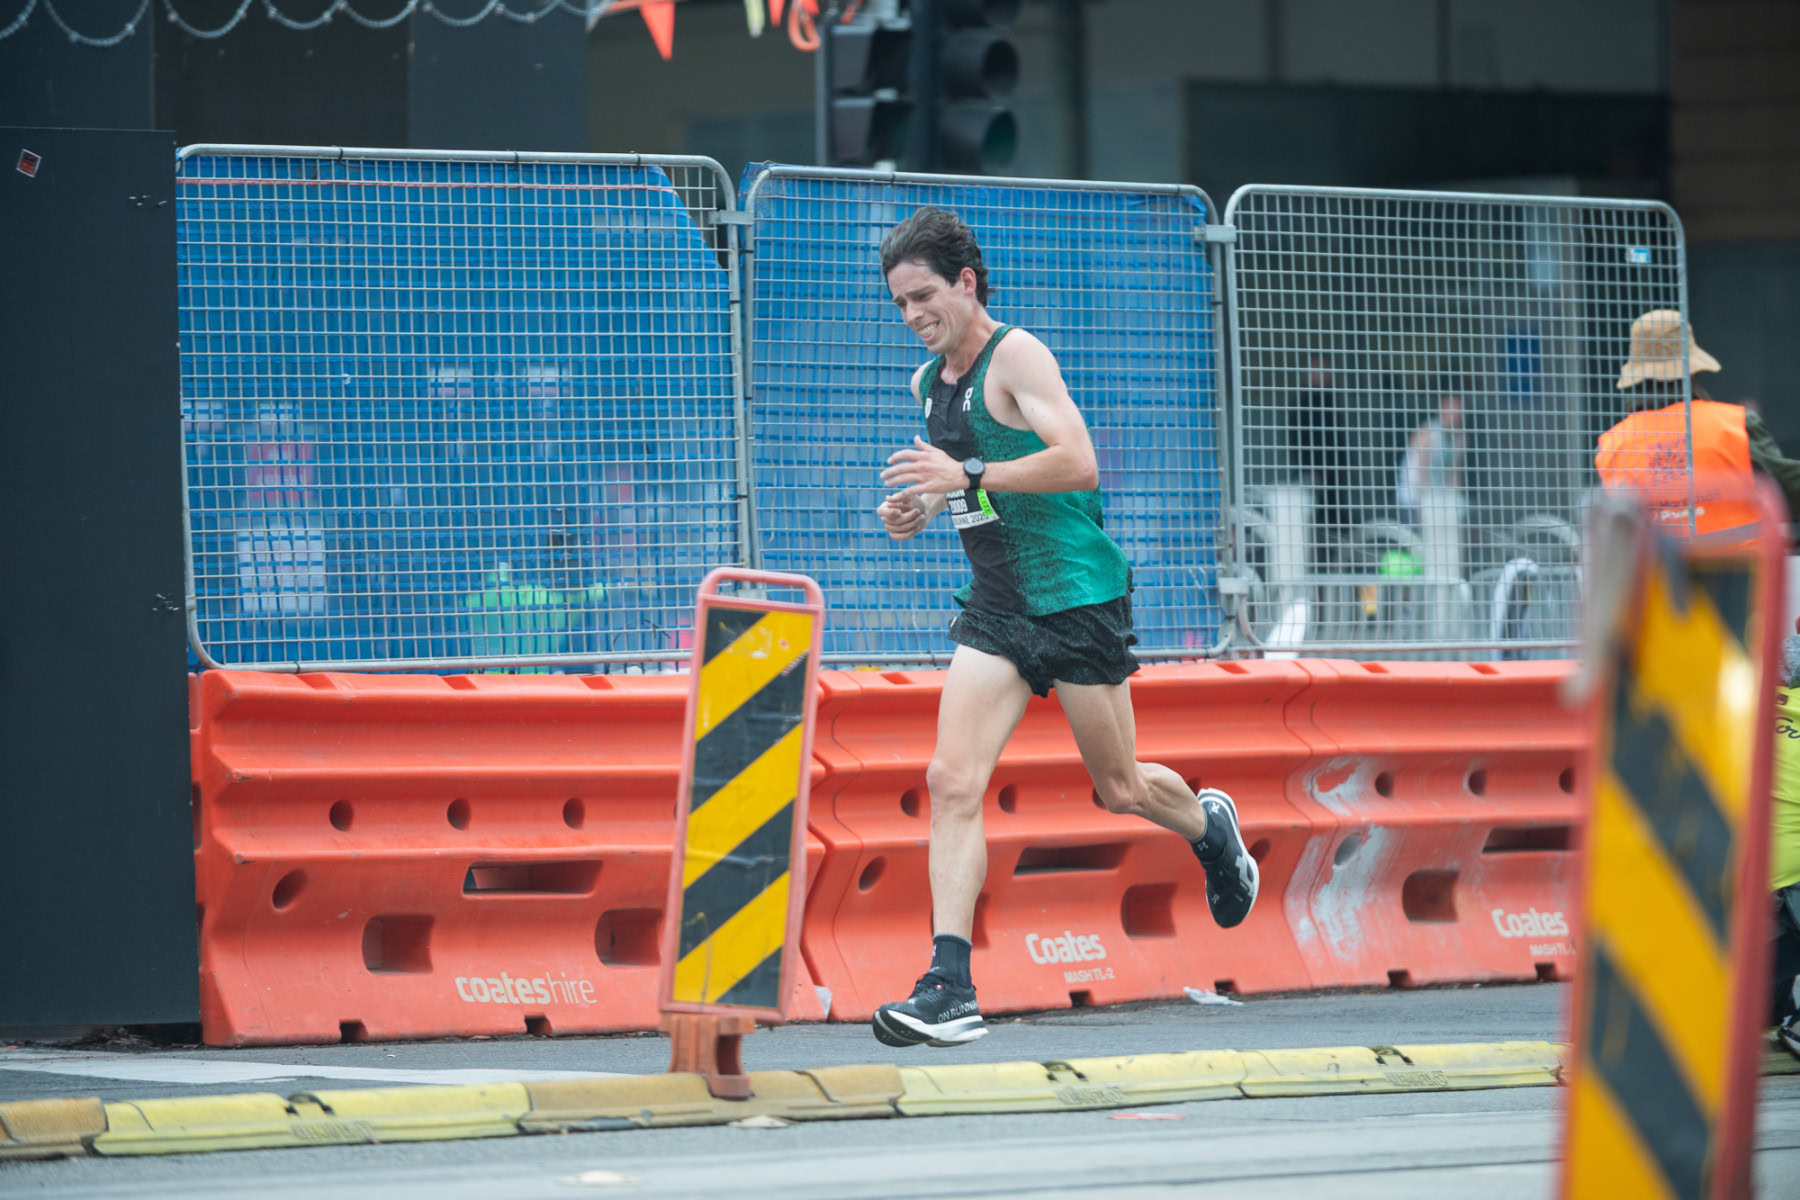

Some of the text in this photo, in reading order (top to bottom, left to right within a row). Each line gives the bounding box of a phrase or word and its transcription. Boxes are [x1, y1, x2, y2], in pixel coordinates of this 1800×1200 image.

[1492, 907, 1569, 938] Coates
[1025, 930, 1107, 964] Coates
[1063, 969, 1094, 983] MASH
[937, 1011, 950, 1024] ON
